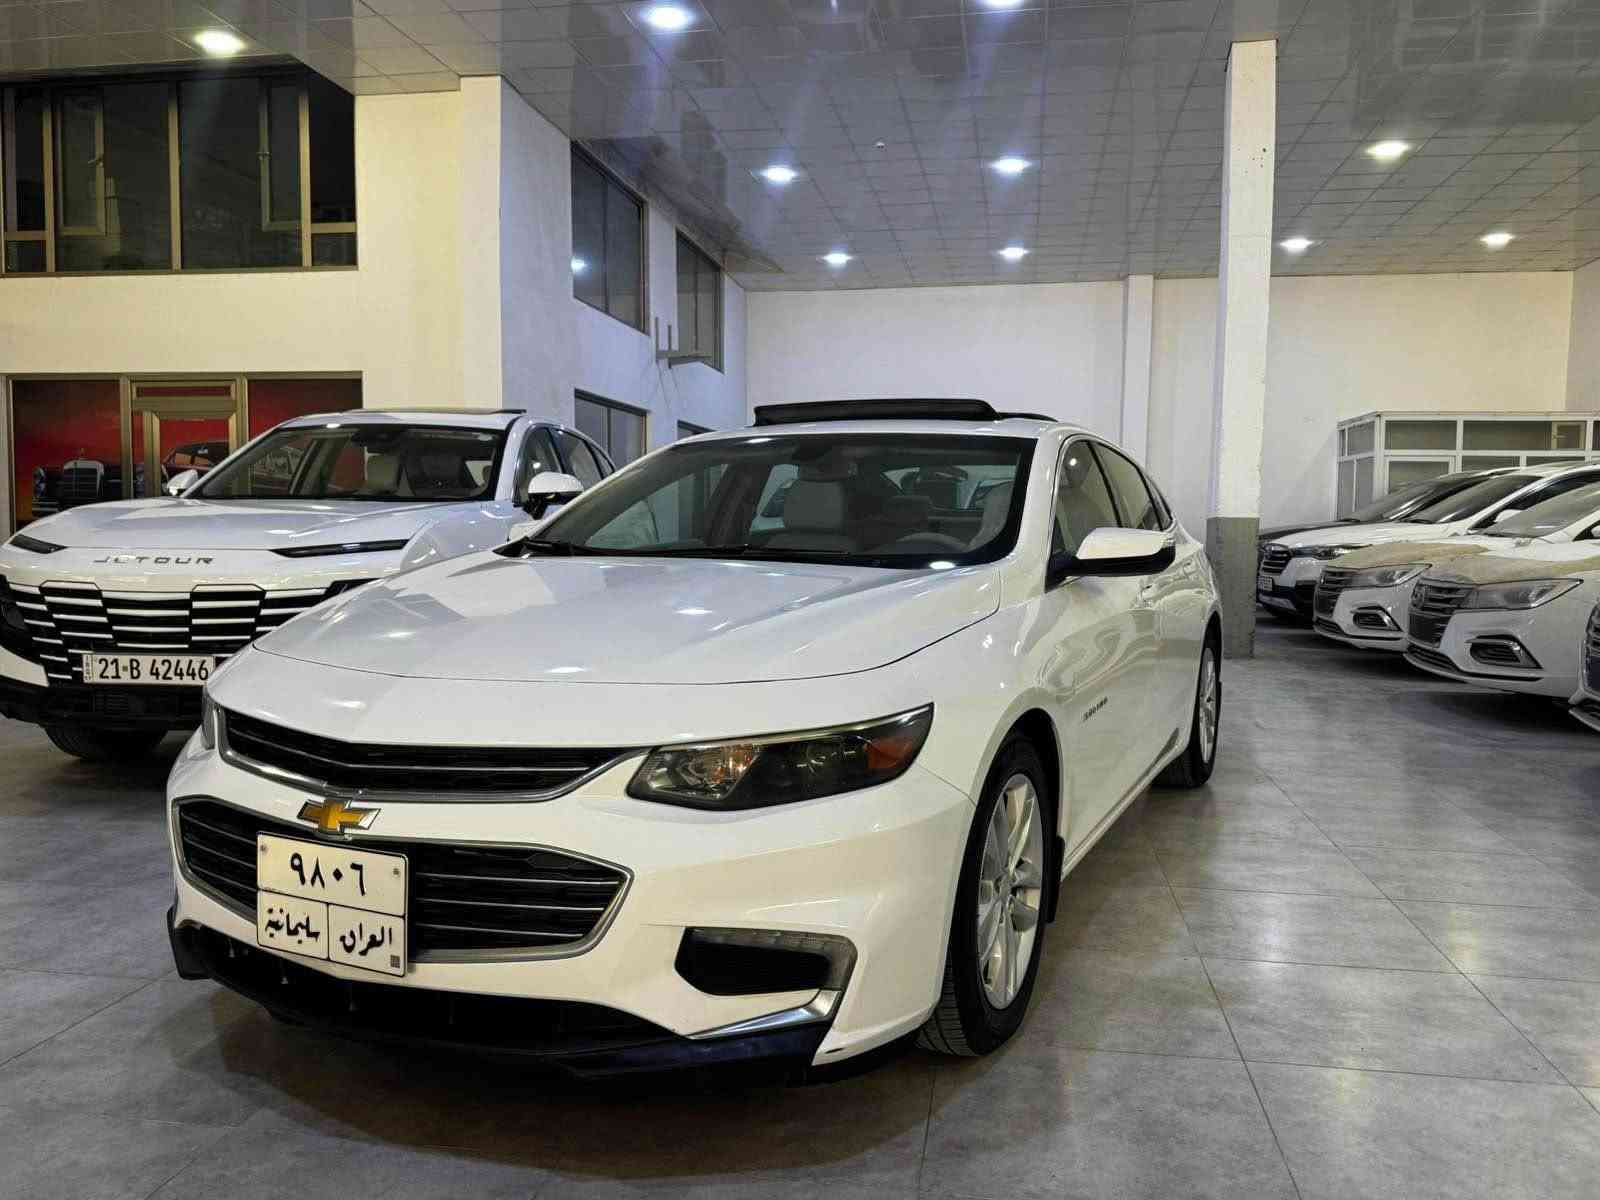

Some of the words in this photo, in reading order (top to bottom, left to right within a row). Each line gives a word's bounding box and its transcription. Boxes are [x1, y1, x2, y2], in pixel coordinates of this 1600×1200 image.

[93, 555, 214, 565] JETOUR
[150, 658, 209, 681] 42446
[290, 852, 366, 897] ٩٨٠٦
